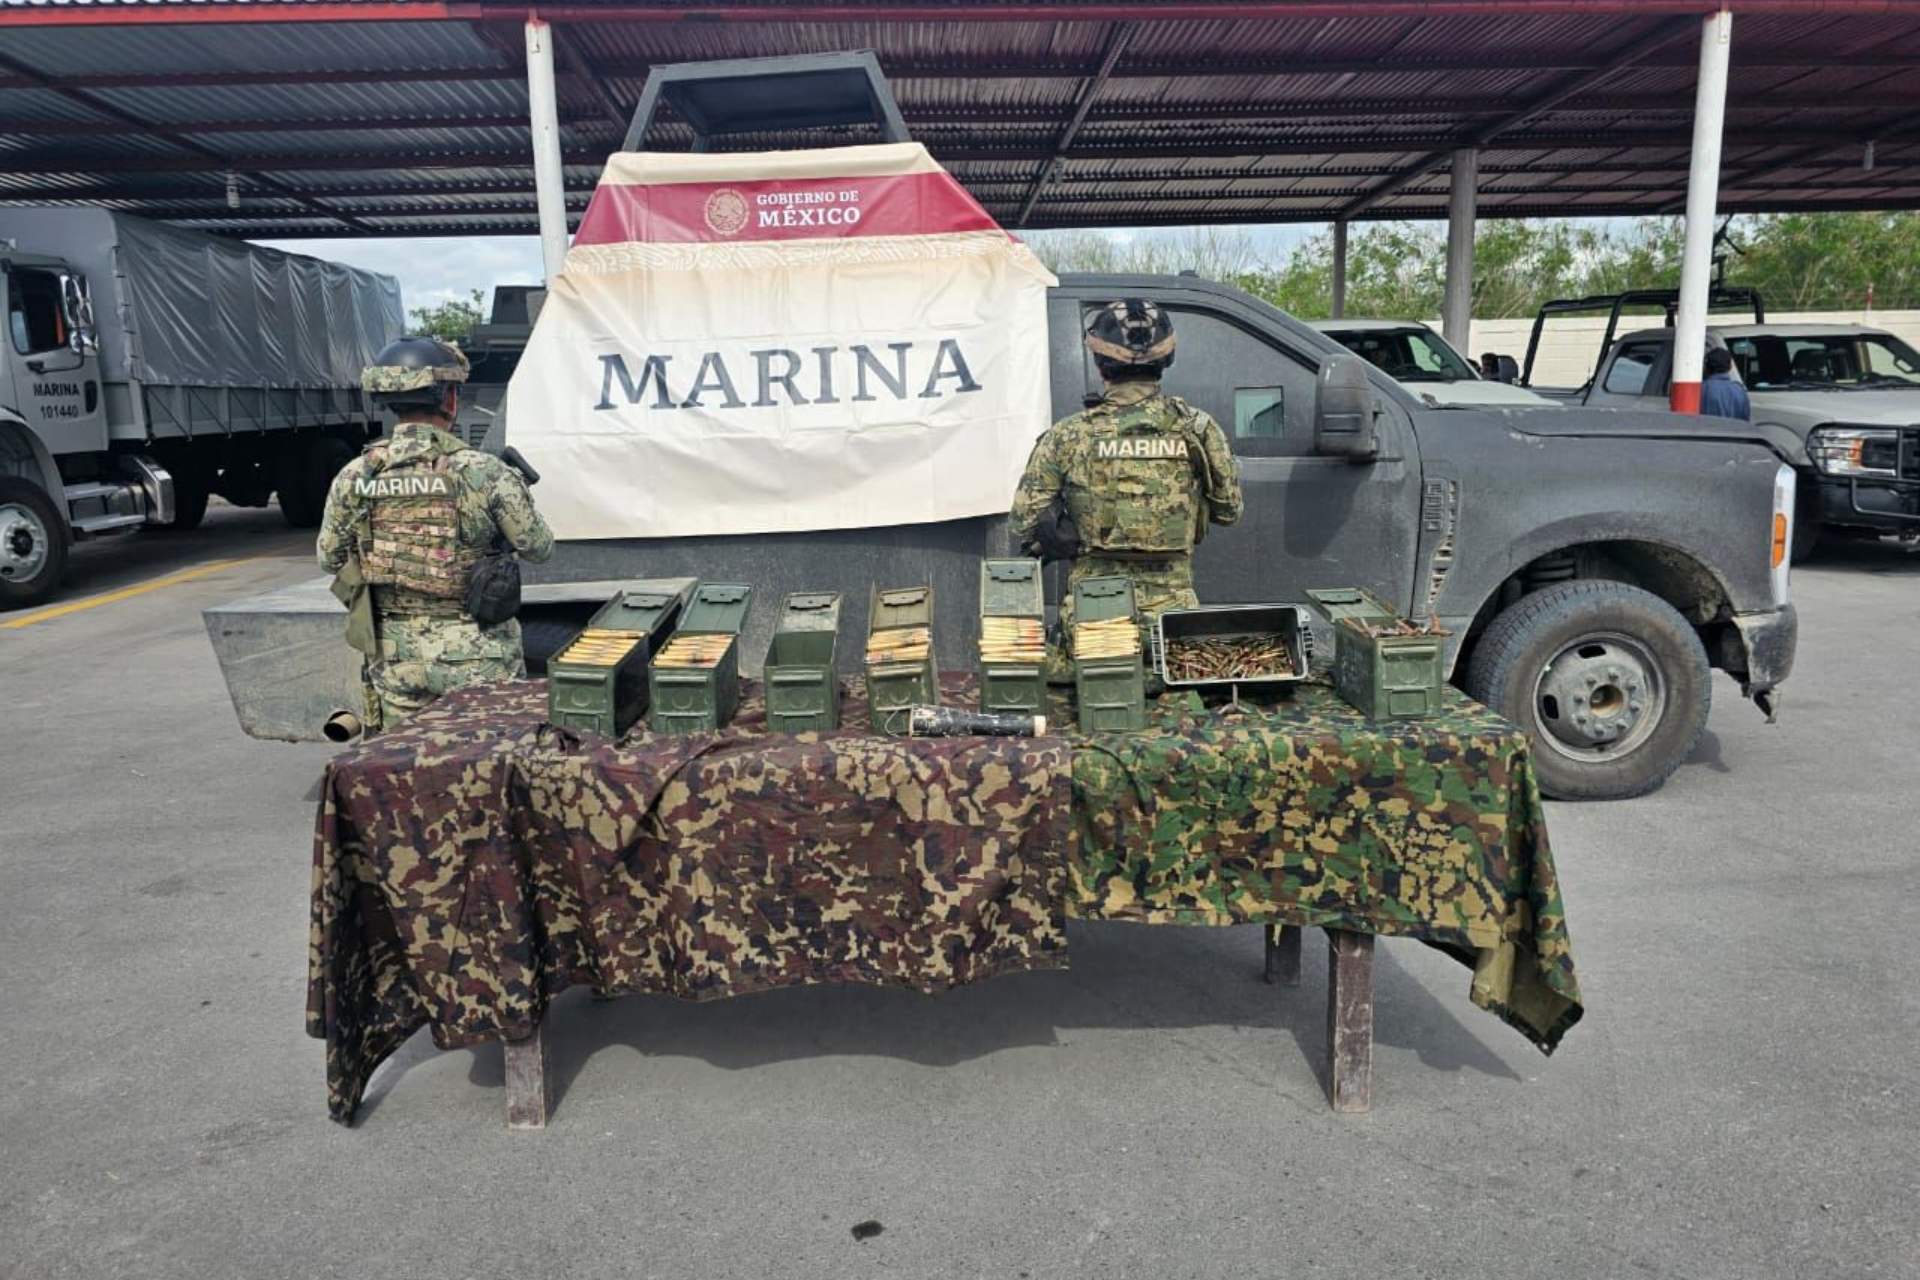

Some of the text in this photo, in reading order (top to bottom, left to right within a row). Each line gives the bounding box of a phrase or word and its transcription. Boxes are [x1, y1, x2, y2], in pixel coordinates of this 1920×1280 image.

[757, 190, 859, 206] GOBIERNO DE
[758, 204, 861, 227] MÉXICO
[594, 338, 983, 411] MARINA
[33, 383, 80, 397] MARINA
[41, 404, 79, 419] 101440
[1098, 439, 1189, 457] MARINA
[354, 477, 448, 496] MARINA
